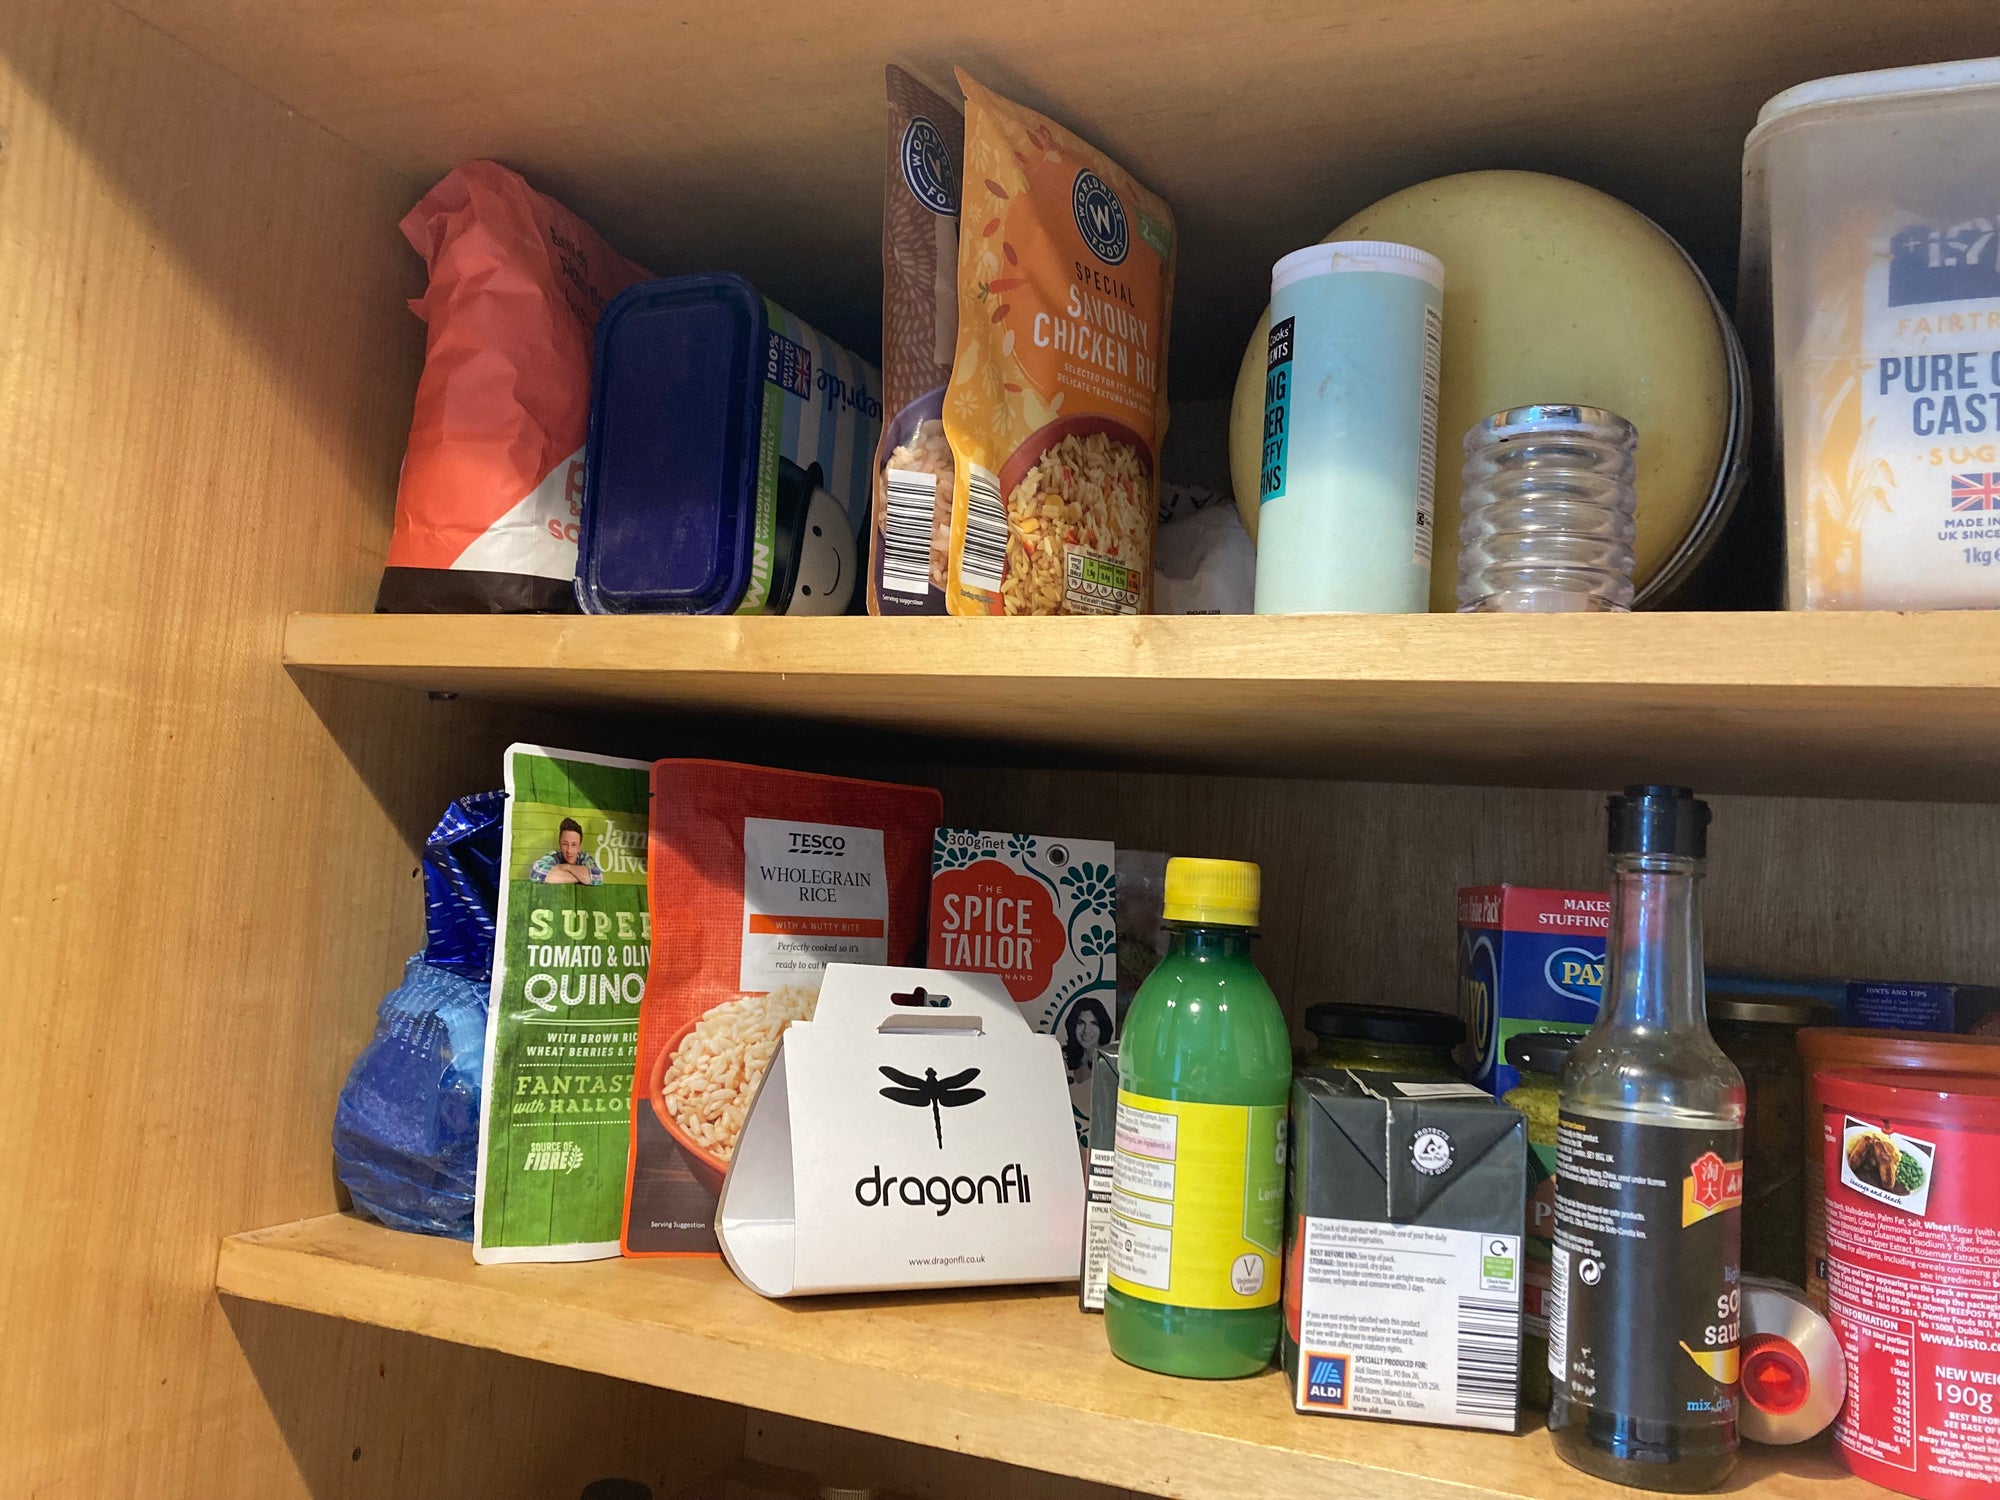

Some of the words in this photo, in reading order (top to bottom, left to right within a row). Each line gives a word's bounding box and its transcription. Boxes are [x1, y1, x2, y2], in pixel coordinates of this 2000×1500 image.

[1078, 177, 1122, 221] WORLDWIDE
[1089, 204, 1111, 235] W
[1092, 237, 1123, 257] FOODS
[1076, 261, 1135, 308] SPECIAL
[1067, 283, 1148, 351] SAVOURY
[1033, 312, 1128, 377] CHICKEN
[767, 334, 780, 380] 100%
[782, 341, 790, 387] BRITISH
[787, 344, 796, 388] WHEAT
[1064, 362, 1100, 382] SELECTED
[1101, 374, 1115, 389] FOR
[1116, 382, 1127, 393] ITS
[1880, 352, 1979, 395] PURE
[1057, 373, 1090, 392] DELICATE
[1092, 386, 1124, 404] TEXTURE
[757, 441, 767, 479] PRIZES
[765, 428, 776, 481] FAMILY
[755, 480, 765, 539] EXCLUSIVE
[762, 485, 772, 540] WHOLE
[1944, 518, 1983, 528] MADE
[1938, 531, 1958, 541] UK
[1963, 547, 1991, 566] 1kg
[739, 541, 770, 609] WIN
[882, 593, 899, 604] Serving
[788, 833, 846, 850] TESCO
[948, 834, 981, 851] 300g
[985, 838, 1005, 850] net
[760, 866, 871, 887] WHOLEGRAIN
[799, 886, 837, 902] RICE
[977, 884, 1002, 894] THE
[943, 893, 1033, 935] SPICE
[776, 920, 798, 930] WITH
[811, 922, 839, 931] NUTTY
[527, 945, 601, 968] TOMATO
[607, 945, 617, 967] &
[777, 941, 810, 953] Perfectly
[811, 943, 837, 953] cooked
[838, 945, 847, 953] so
[849, 944, 859, 953] it's
[941, 932, 1033, 970] TAILOR
[775, 961, 797, 971] ready
[798, 962, 806, 970] to
[808, 962, 820, 970] eat
[1866, 987, 1890, 996] HINTS
[1910, 990, 1928, 998] TIPS
[547, 1032, 577, 1043] WITH
[580, 1033, 619, 1043] BROWN
[527, 1046, 565, 1057] WHEAT
[569, 1046, 614, 1057] BERRIES
[617, 1046, 624, 1056] &
[513, 1098, 546, 1114] with
[530, 1142, 562, 1152] SOURCE
[563, 1141, 573, 1151] OF
[524, 1151, 568, 1171] FIBRE
[651, 1221, 672, 1229] Serving
[673, 1221, 705, 1229] Suggestion
[1877, 1213, 1894, 1223] Palm
[1894, 1217, 1906, 1226] Fat,
[1908, 1218, 1923, 1229] Salt,
[1924, 1221, 1952, 1232] Wheat
[1953, 1225, 1973, 1234] Flour
[1975, 1227, 1995, 1237] (with
[1877, 1222, 1912, 1235] (Ammonia
[1912, 1229, 1949, 1242] Caramel),
[1950, 1234, 1975, 1245] Sugar,
[1324, 1250, 1344, 1258] BEFORE
[1867, 1237, 1888, 1249] Pepper
[1889, 1243, 1914, 1255] Extract,
[1915, 1247, 1953, 1261] Rosemary
[1953, 1253, 1982, 1265] Extract,
[1909, 1238, 1945, 1250] Disodium
[908, 1255, 986, 1266] www.dragonfli.co.uk
[1883, 1255, 1916, 1269] including
[1917, 1262, 1946, 1271] cereals
[1946, 1265, 1991, 1279] containing
[1877, 1275, 1908, 1289] appearing
[1920, 1283, 1934, 1294] this
[1936, 1288, 1954, 1297] pack
[1970, 1292, 1998, 1300] owned
[1920, 1272, 1933, 1280] see
[1935, 1273, 1981, 1286] ingredients
[1906, 1291, 1930, 1301] please
[1931, 1295, 1951, 1306] keep
[1952, 1298, 1966, 1307] the
[1842, 1306, 1898, 1331] INFORMATION
[1921, 1311, 1951, 1323] Premier
[1952, 1317, 1976, 1327] Foods
[1958, 1326, 1984, 1336] Dublin
[1355, 1355, 1383, 1365] SPECIALLY
[1384, 1358, 1413, 1368] PRODUCED
[1935, 1365, 1967, 1381] NEW
[1310, 1386, 1341, 1398] ALDI
[1935, 1382, 1993, 1414] 190g
